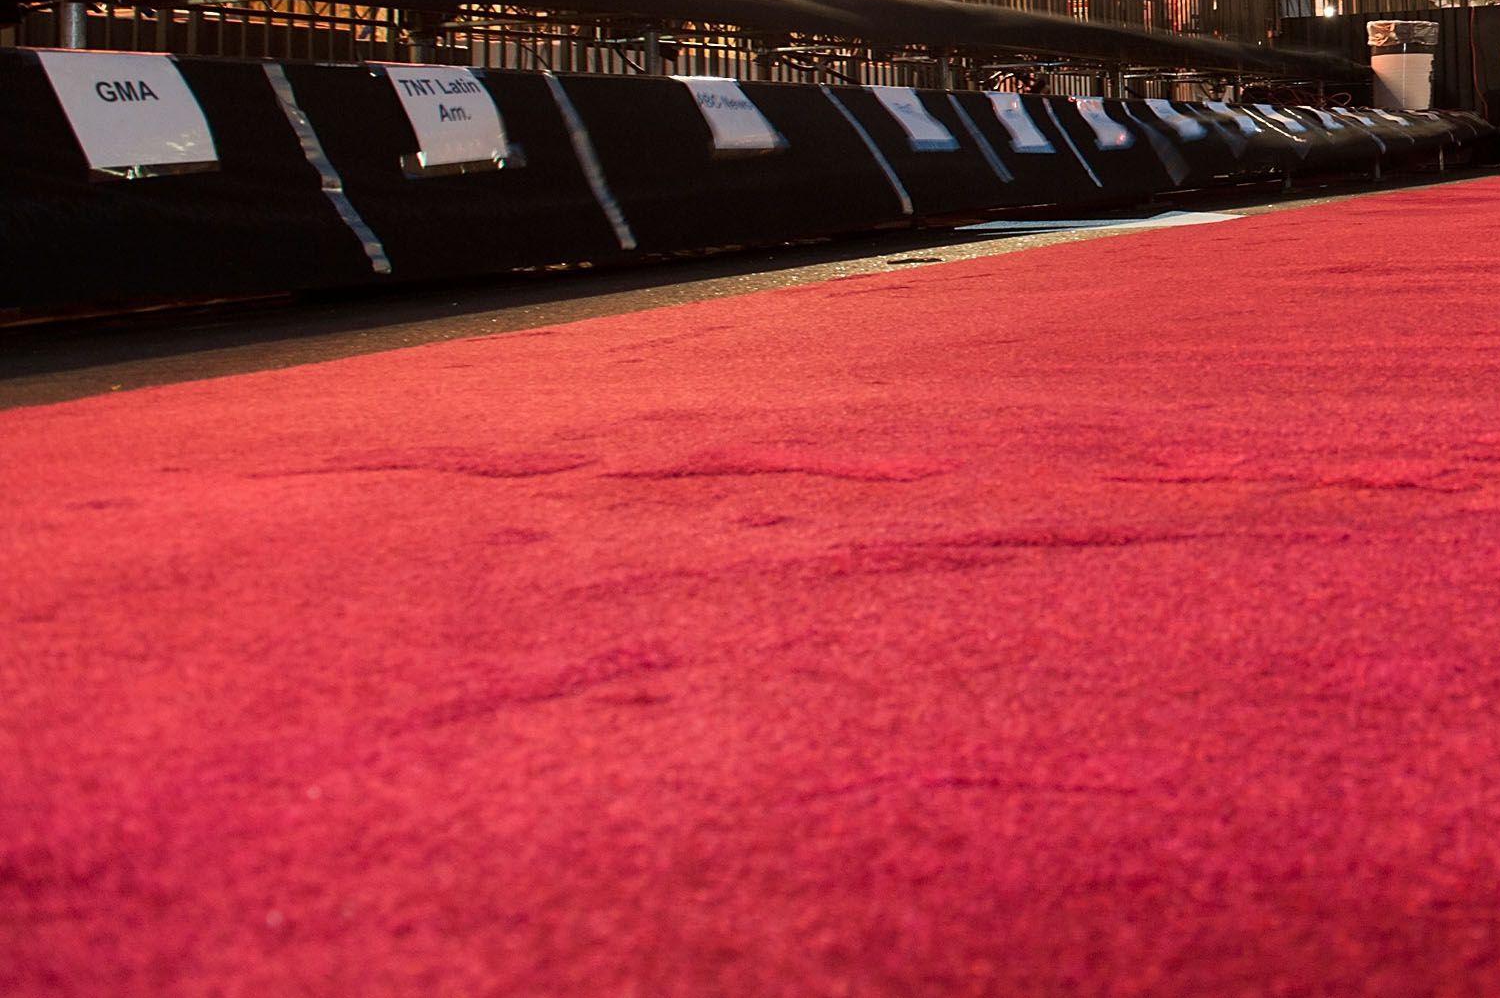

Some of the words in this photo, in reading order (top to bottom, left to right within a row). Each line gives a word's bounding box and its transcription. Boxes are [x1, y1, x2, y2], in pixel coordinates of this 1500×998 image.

[95, 80, 160, 103] GMA
[398, 79, 436, 97] TNT
[435, 78, 481, 95] Latin
